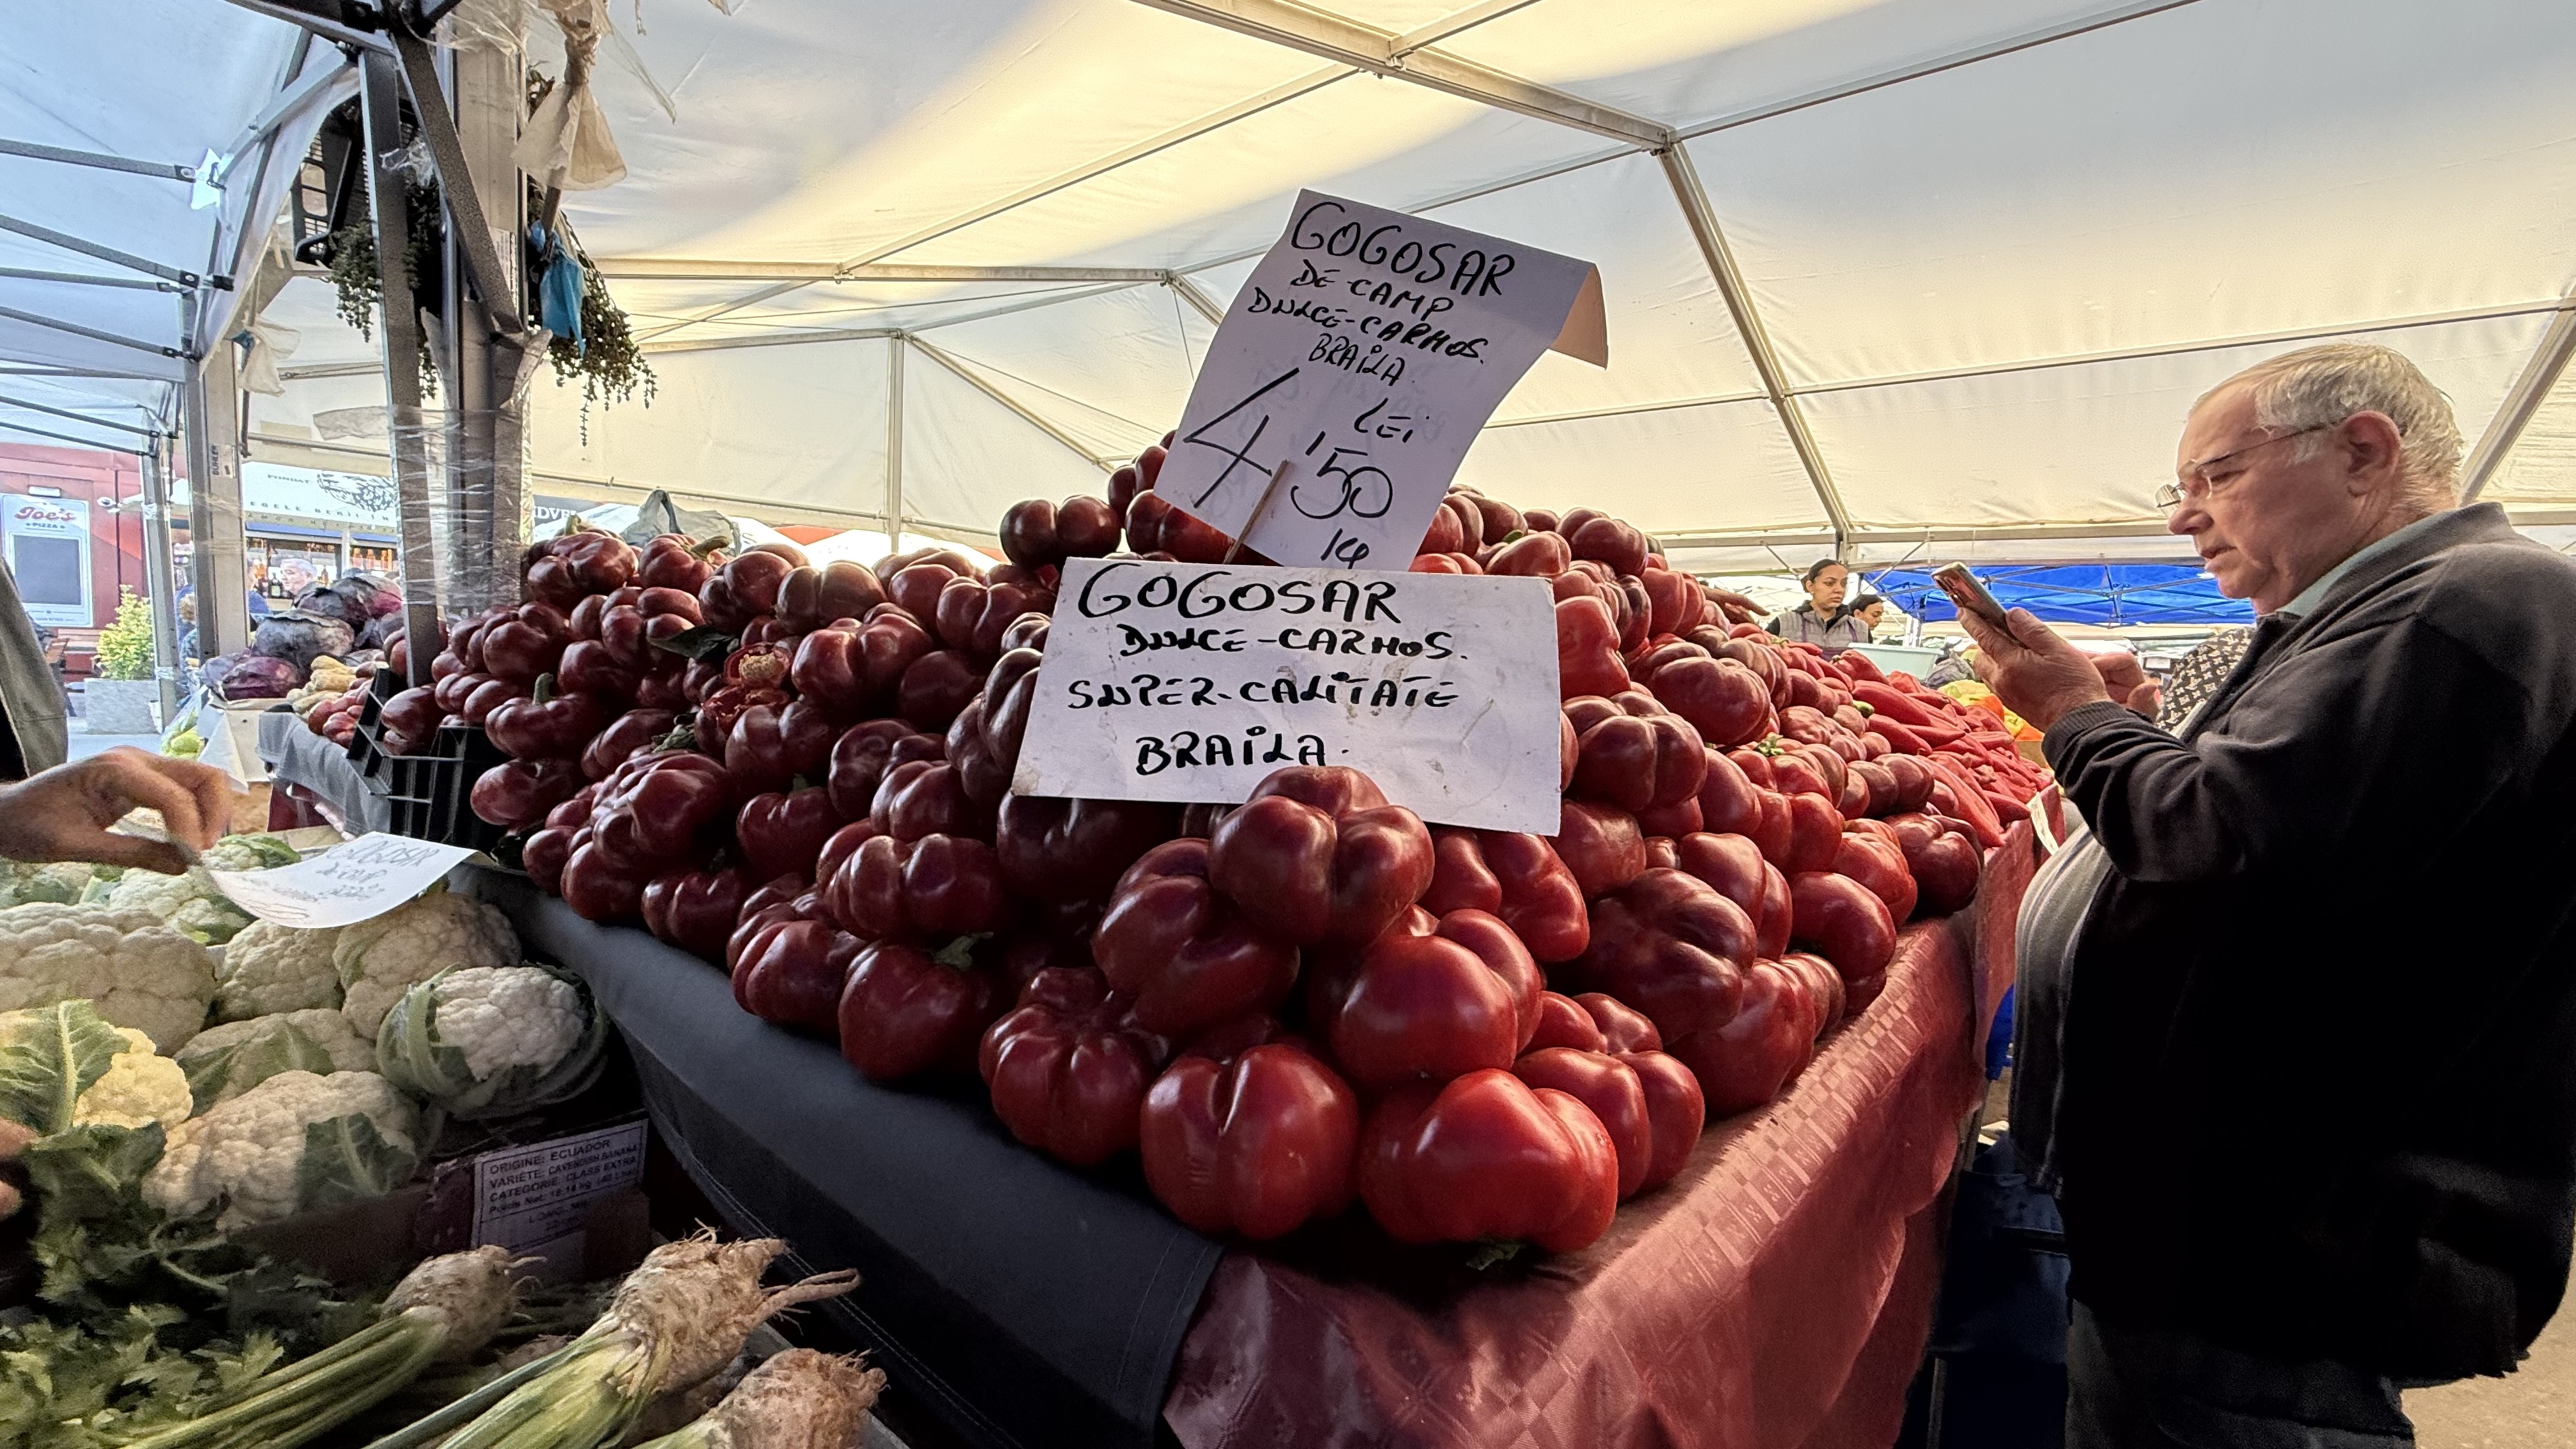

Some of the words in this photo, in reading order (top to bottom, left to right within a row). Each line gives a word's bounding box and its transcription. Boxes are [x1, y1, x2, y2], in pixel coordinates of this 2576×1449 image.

[1291, 201, 1515, 296] GOGOSAR
[1290, 259, 1340, 288] DE
[15, 506, 76, 521] Joe's
[1078, 562, 1402, 624] GOGOSAR
[551, 1139, 610, 1161] ECUADOR
[549, 1155, 600, 1175] CAVENDISH
[604, 1156, 636, 1170] EXTRA
